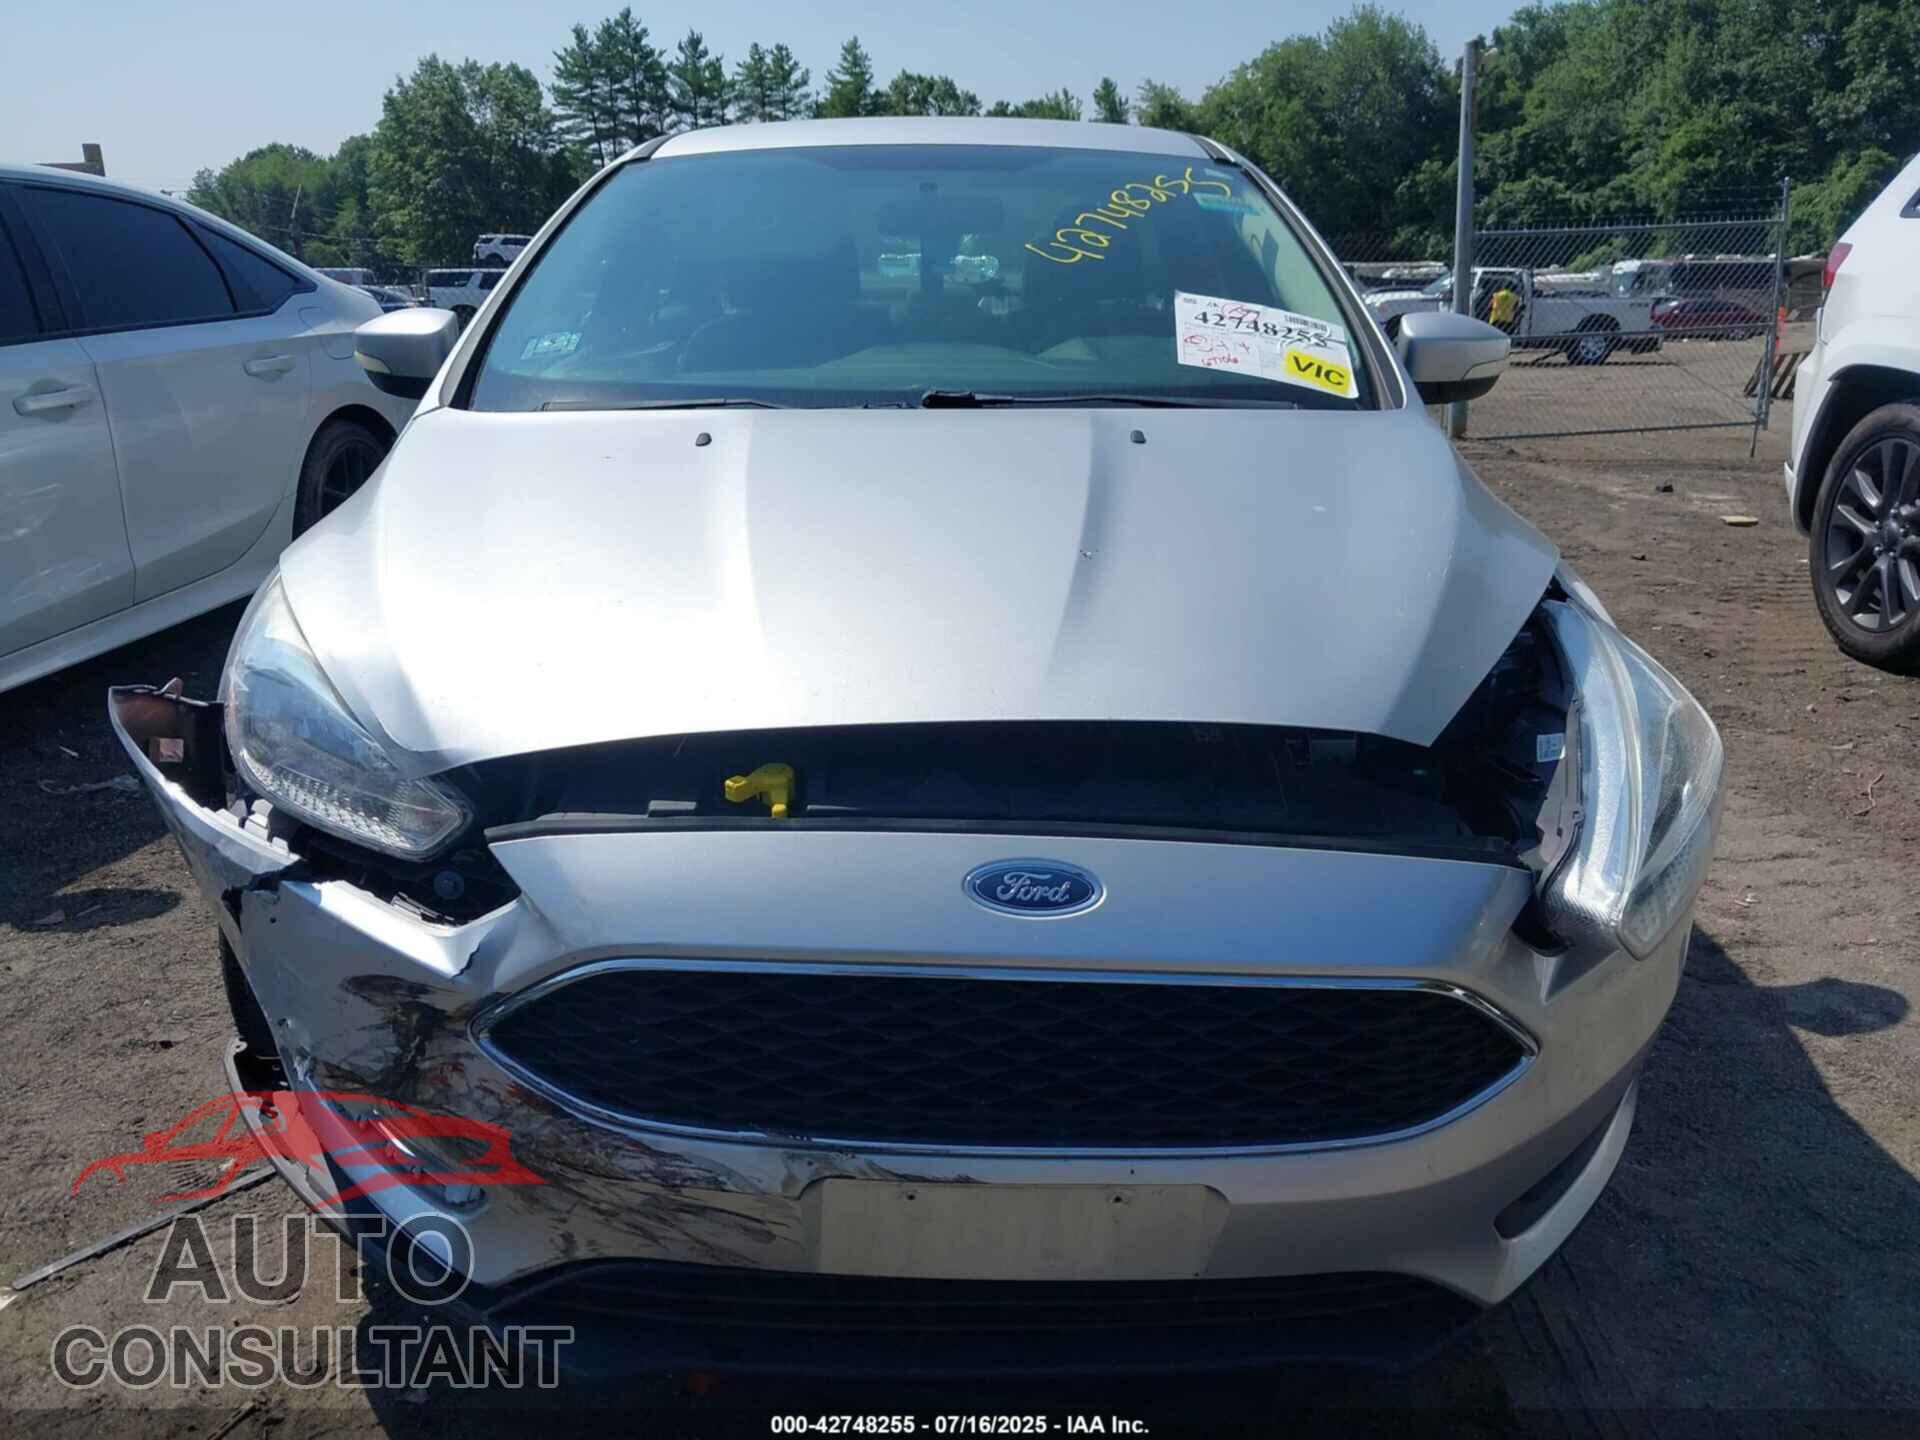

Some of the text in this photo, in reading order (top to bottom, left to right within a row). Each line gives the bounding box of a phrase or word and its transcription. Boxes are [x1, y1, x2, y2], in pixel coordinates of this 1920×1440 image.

[1194, 311, 1329, 348] 42748255
[1292, 354, 1345, 387] VIC
[996, 871, 1072, 903] Ford
